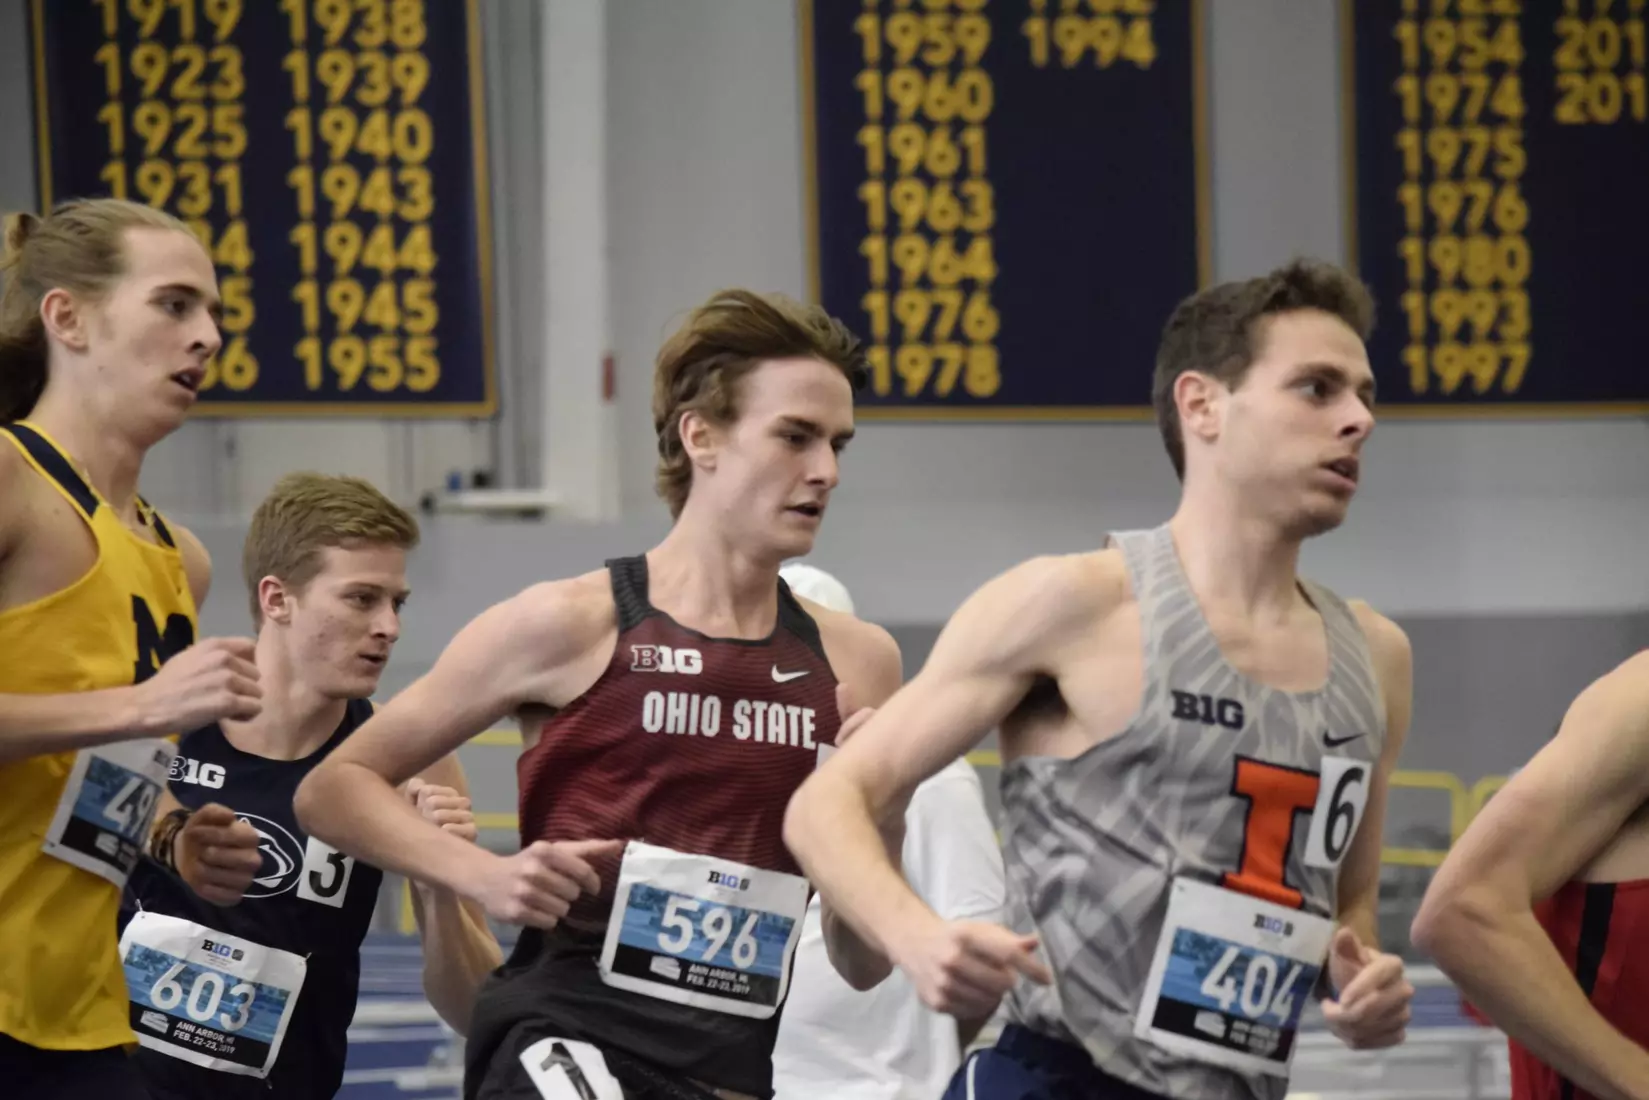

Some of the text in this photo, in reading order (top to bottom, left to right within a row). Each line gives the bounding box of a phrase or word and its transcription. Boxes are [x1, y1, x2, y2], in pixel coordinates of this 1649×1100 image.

[97, 0, 243, 42] 1919
[280, 0, 427, 48] 1938
[854, 13, 990, 66] 1959
[1022, 15, 1157, 68] 1994
[1393, 18, 1525, 71] 1954
[1554, 18, 1648, 71] 201
[95, 43, 244, 99] 1923
[282, 49, 431, 105] 1939
[855, 68, 993, 121] 1960
[1394, 72, 1525, 123] 1974
[1555, 72, 1648, 124] 201
[97, 102, 247, 159] 1925
[285, 107, 433, 164] 1940
[856, 123, 987, 177] 1961
[1395, 126, 1526, 178] 1975
[101, 158, 243, 216] 1931
[287, 164, 434, 220] 1943
[858, 178, 995, 232] 1963
[1397, 180, 1529, 232] 1976
[290, 220, 437, 277] 1944
[860, 233, 997, 287] 1964
[1399, 234, 1531, 287] 1980
[293, 279, 439, 334] 1945
[862, 289, 999, 342] 1976
[1401, 288, 1531, 341] 1993
[294, 336, 440, 391] 1955
[867, 343, 1000, 398] 1978
[1402, 342, 1532, 394] 1997
[642, 691, 816, 750] OHIO STATE
[1324, 767, 1364, 863] 6
[309, 852, 349, 898] 3
[657, 896, 758, 970] 596
[151, 963, 256, 1032] 603
[1201, 946, 1303, 1026] 404
[173, 1030, 192, 1042] FEB.
[176, 1021, 196, 1033] ANN
